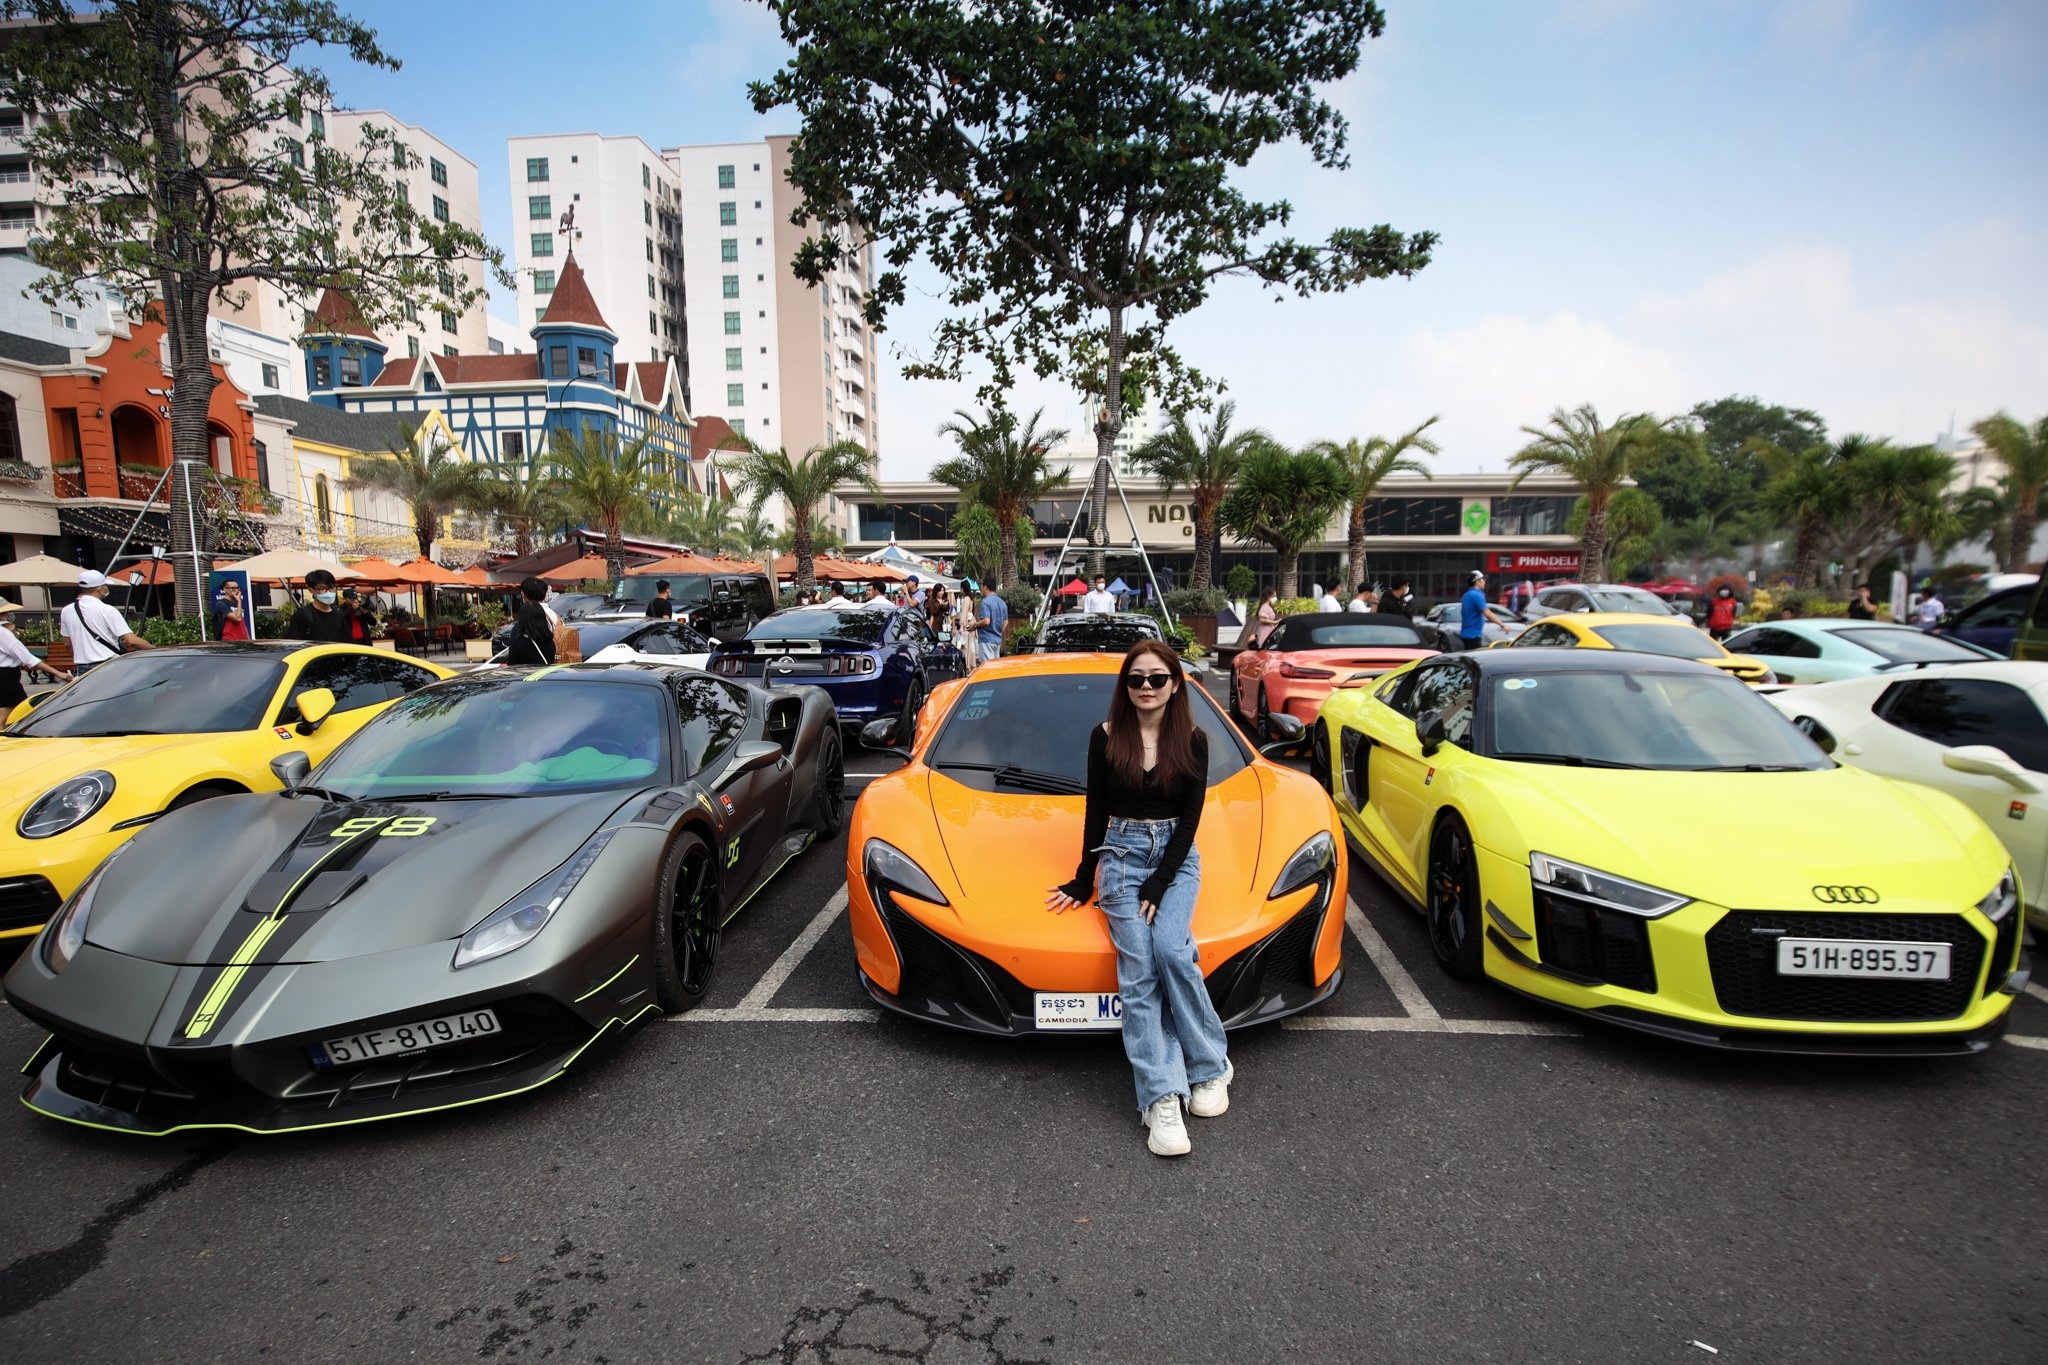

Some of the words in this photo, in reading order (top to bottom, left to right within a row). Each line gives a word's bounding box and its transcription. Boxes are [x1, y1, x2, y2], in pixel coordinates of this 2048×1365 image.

[1518, 556, 1579, 567] PHINDELI
[964, 708, 985, 719] KH
[1792, 946, 1937, 973] 51H-895.97
[327, 1012, 495, 1062] 51F-819.40
